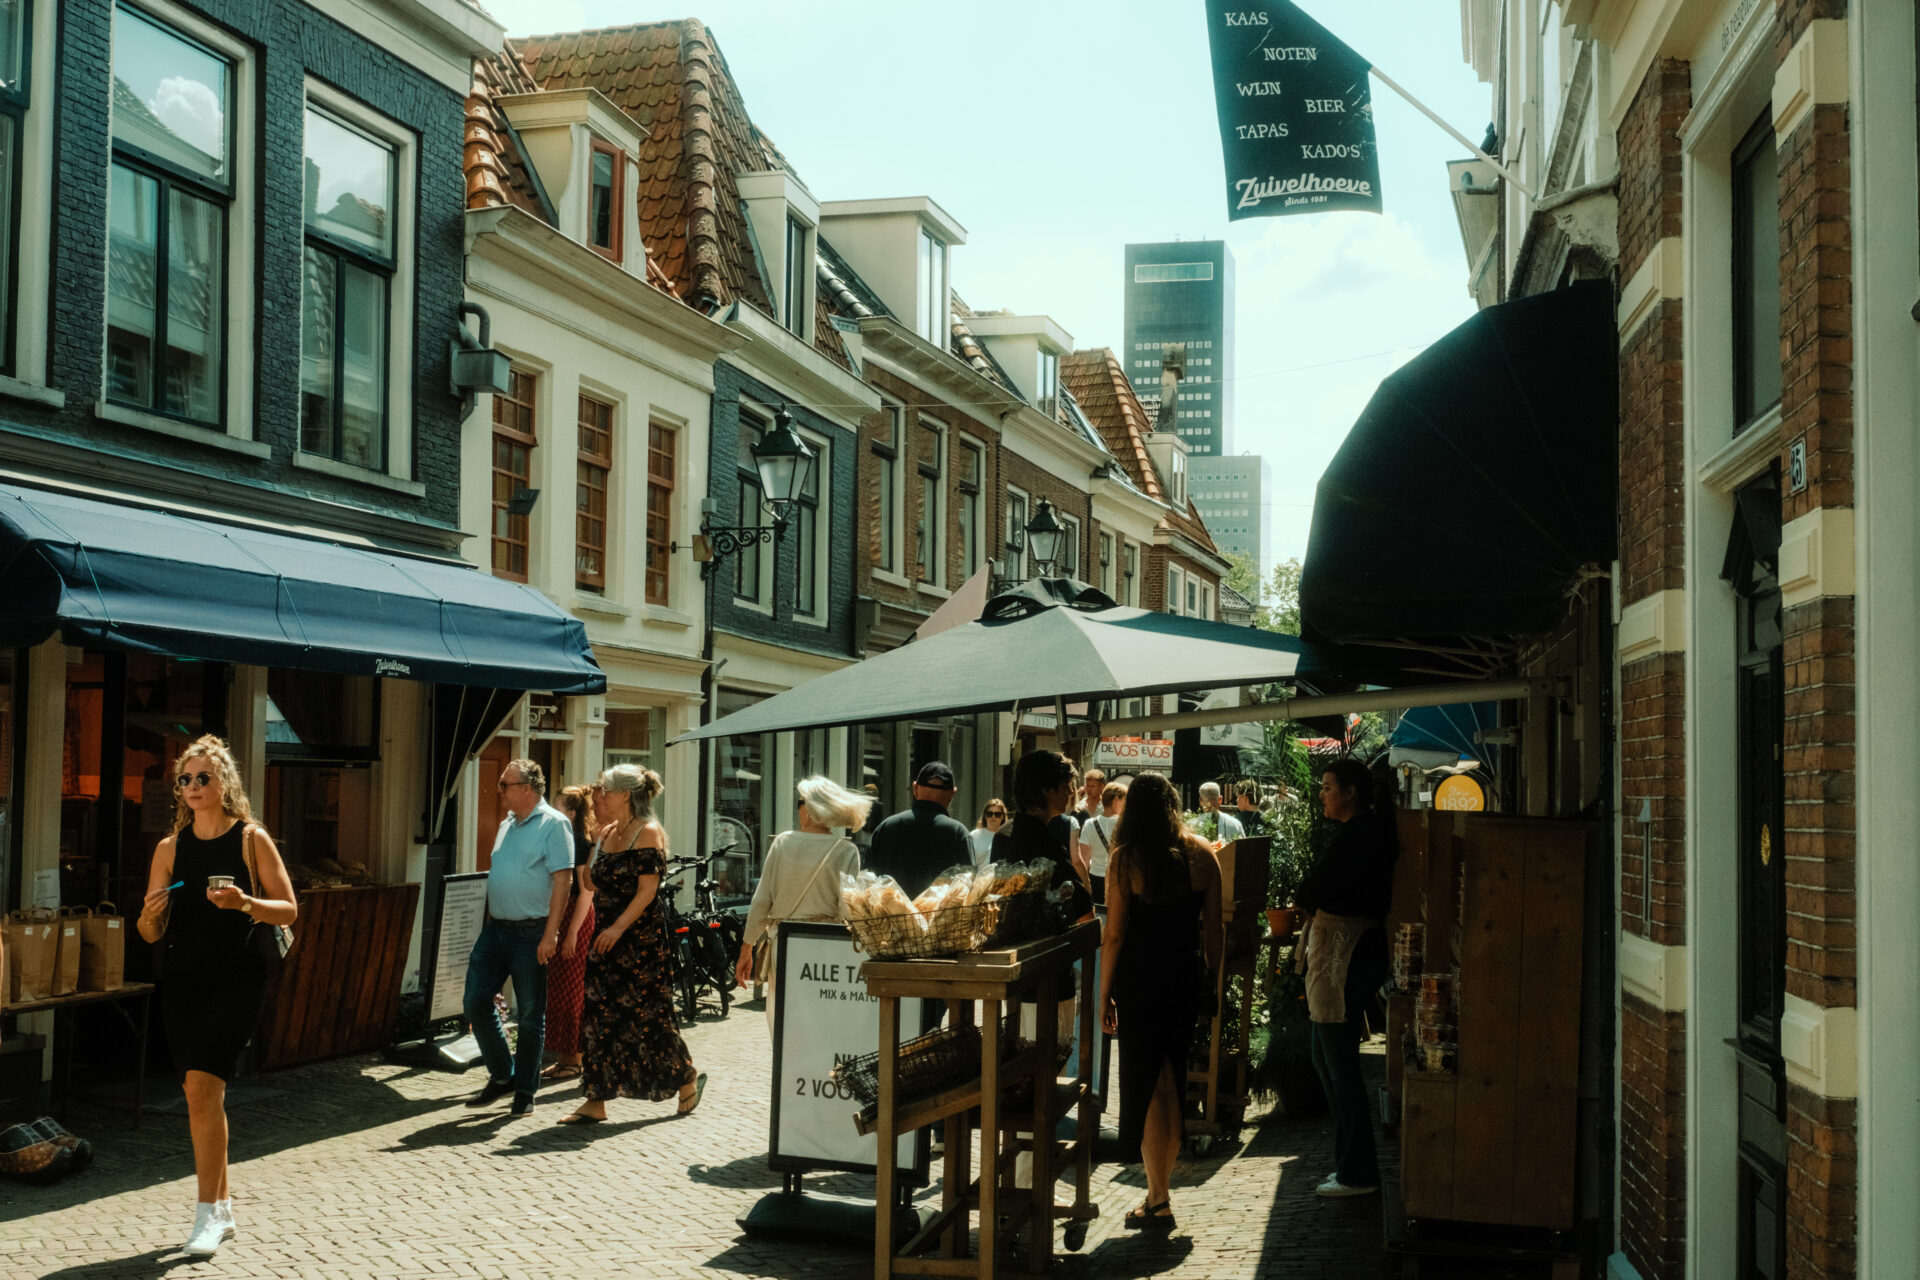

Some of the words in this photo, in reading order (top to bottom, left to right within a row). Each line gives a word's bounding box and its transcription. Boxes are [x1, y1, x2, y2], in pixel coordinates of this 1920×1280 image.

[1224, 12, 1269, 26] KAAS
[1263, 47, 1318, 61] NOTEN
[1236, 81, 1281, 97] WIJN
[1304, 99, 1346, 113] BIER
[1235, 123, 1289, 140] TAPAS
[1301, 144, 1361, 159] KADO'S
[1235, 173, 1373, 210] Zuivelhoeve
[1284, 197, 1309, 207] Sinds
[1113, 744, 1138, 757] VOS
[1147, 746, 1170, 759] VOS
[1441, 797, 1478, 810] 1892
[799, 962, 840, 983] ALLE
[846, 965, 868, 984] TA
[819, 988, 837, 1000] MIX
[840, 991, 848, 1000] &
[796, 1077, 806, 1096] 2
